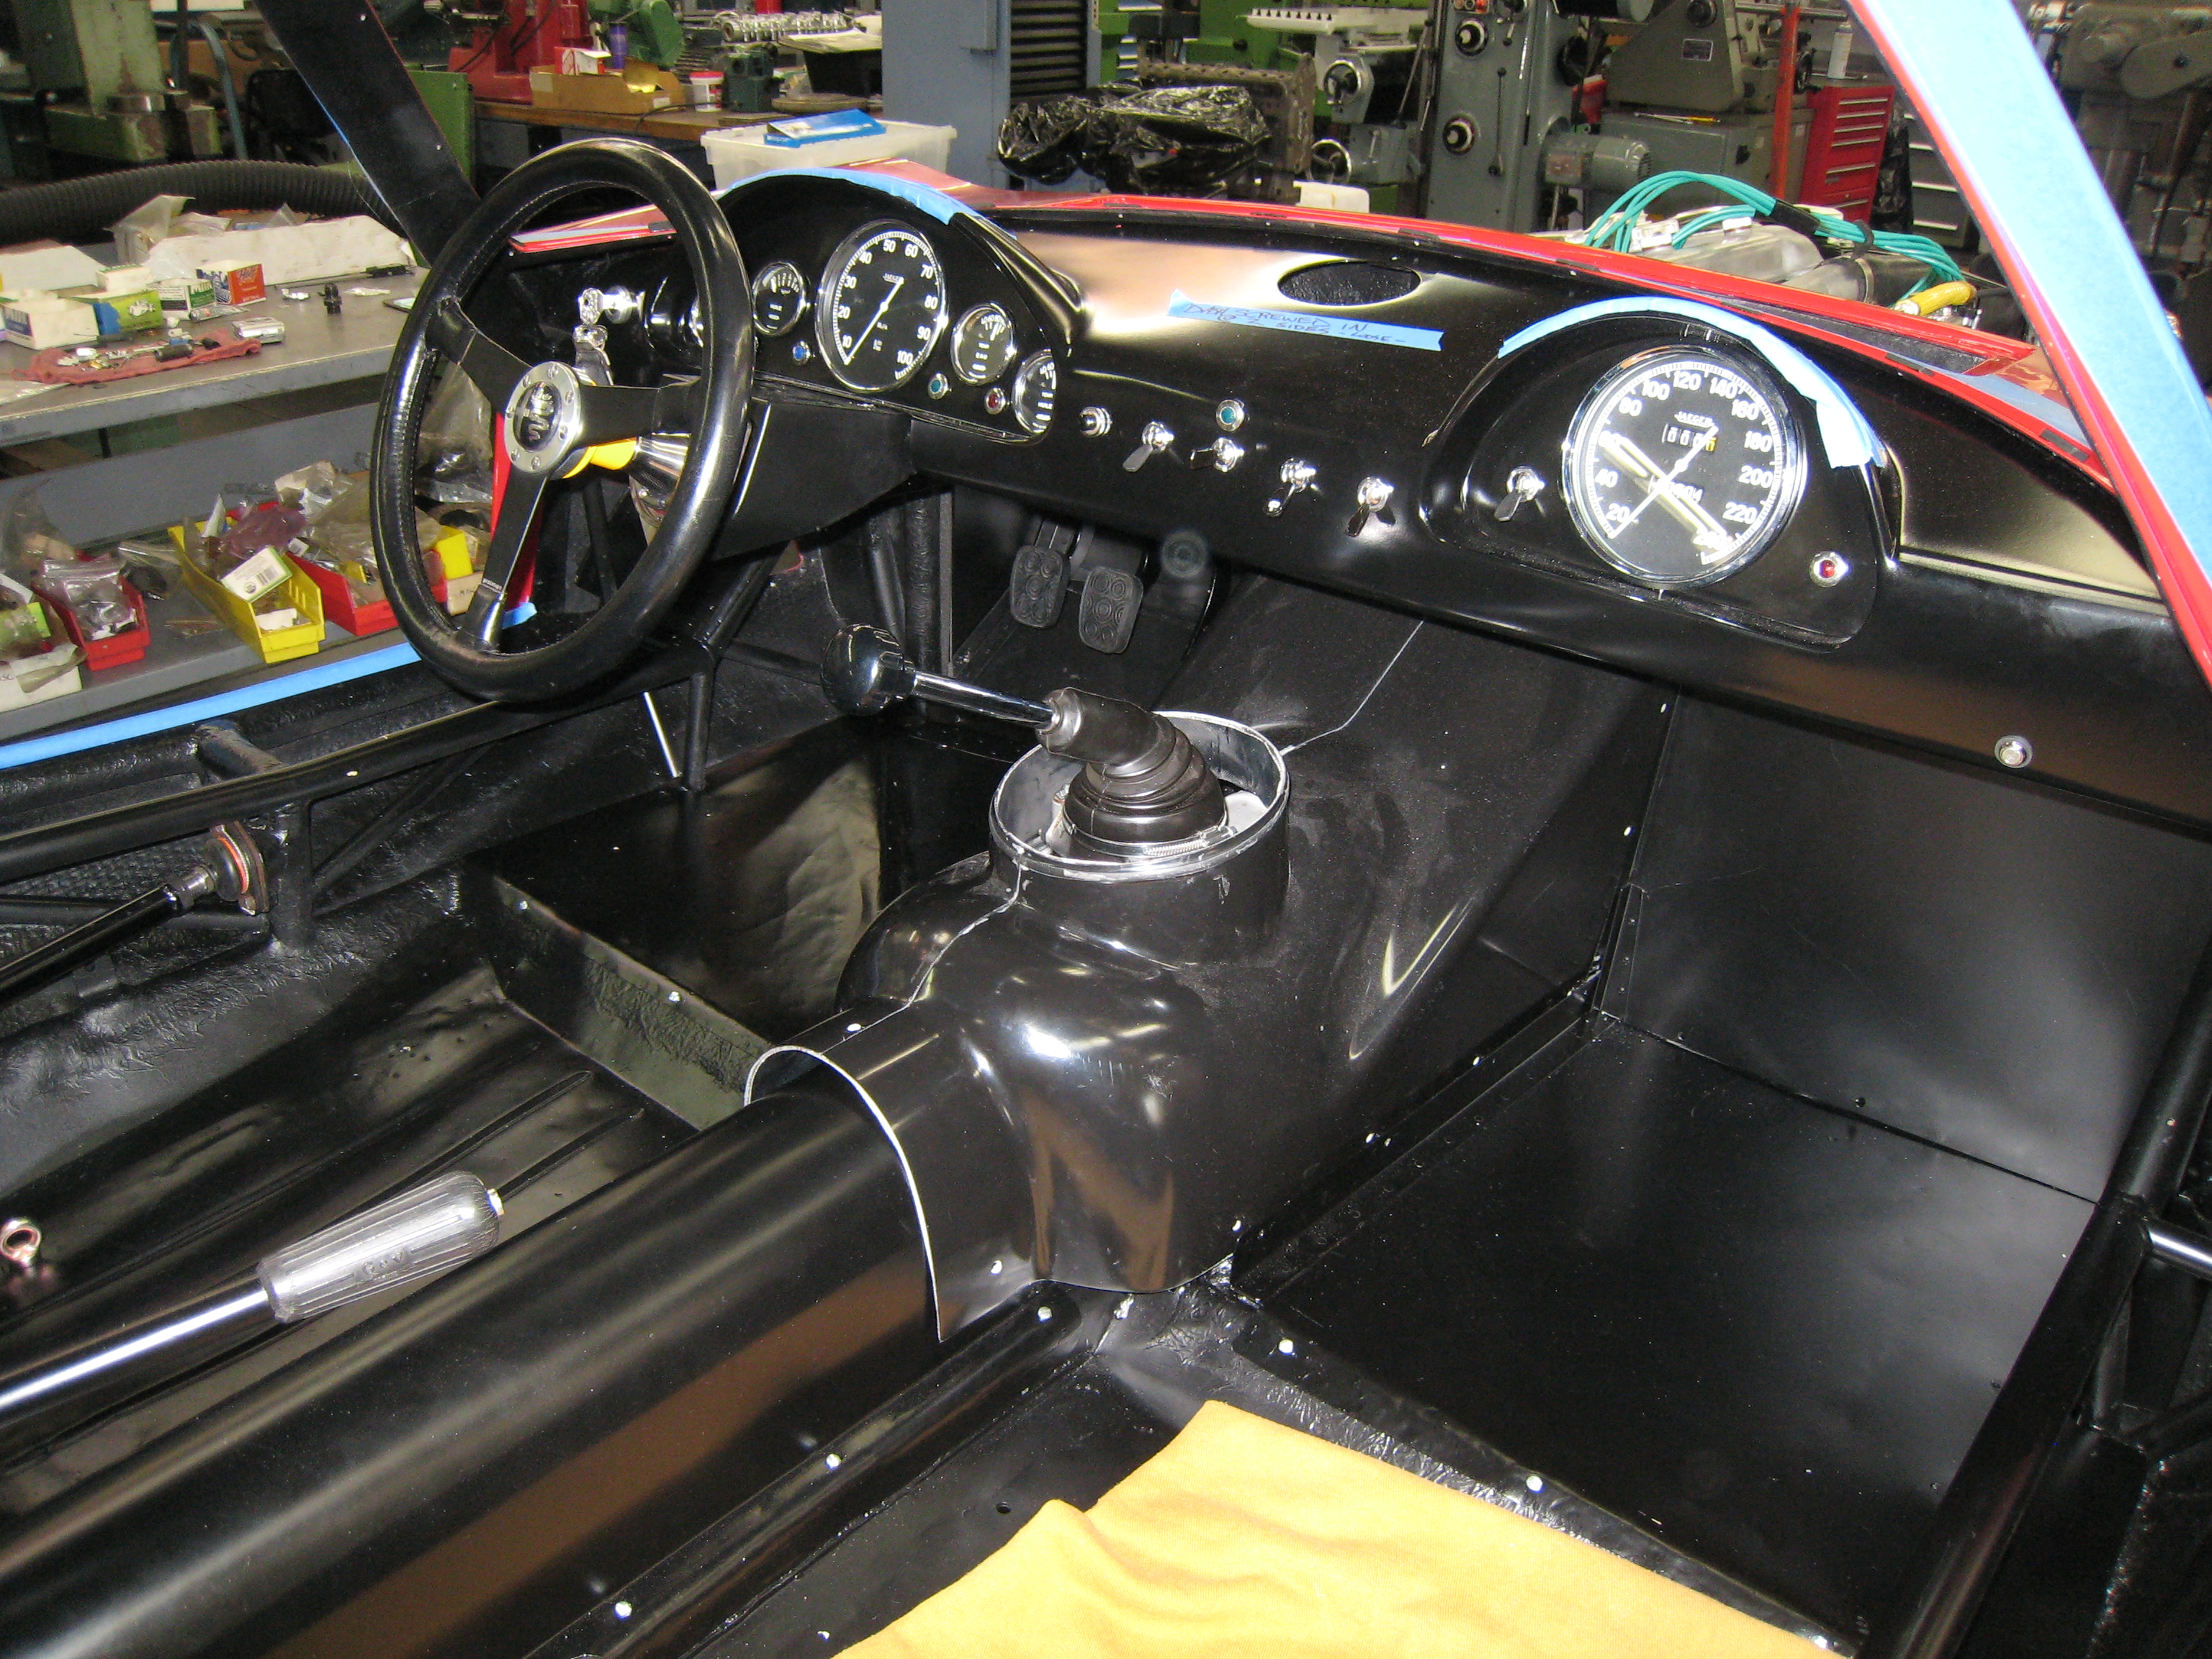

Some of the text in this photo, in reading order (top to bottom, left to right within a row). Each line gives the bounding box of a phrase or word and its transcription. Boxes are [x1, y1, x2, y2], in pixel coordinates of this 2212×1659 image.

[883, 240, 896, 253] 50
[905, 243, 918, 258] 60
[859, 251, 873, 264] 40
[921, 264, 933, 279] 70
[844, 276, 857, 289] 30
[925, 295, 938, 310] 80
[838, 306, 851, 319] 20
[1236, 310, 1331, 326] SCREWED
[1341, 323, 1368, 332] IN
[842, 335, 853, 349] 10
[917, 326, 930, 341] 90
[896, 350, 913, 365] 100
[1673, 369, 1701, 391] 120
[1709, 377, 1738, 399] 140
[1642, 379, 1671, 400] 100
[1619, 397, 1642, 417] 80
[1731, 399, 1760, 421] 160
[1676, 411, 1714, 428] JAEGER
[1744, 431, 1773, 453] 180
[1594, 468, 1619, 488] 40
[1738, 464, 1774, 489] 200
[1605, 503, 1631, 523] 20
[1722, 502, 1758, 525] 220
